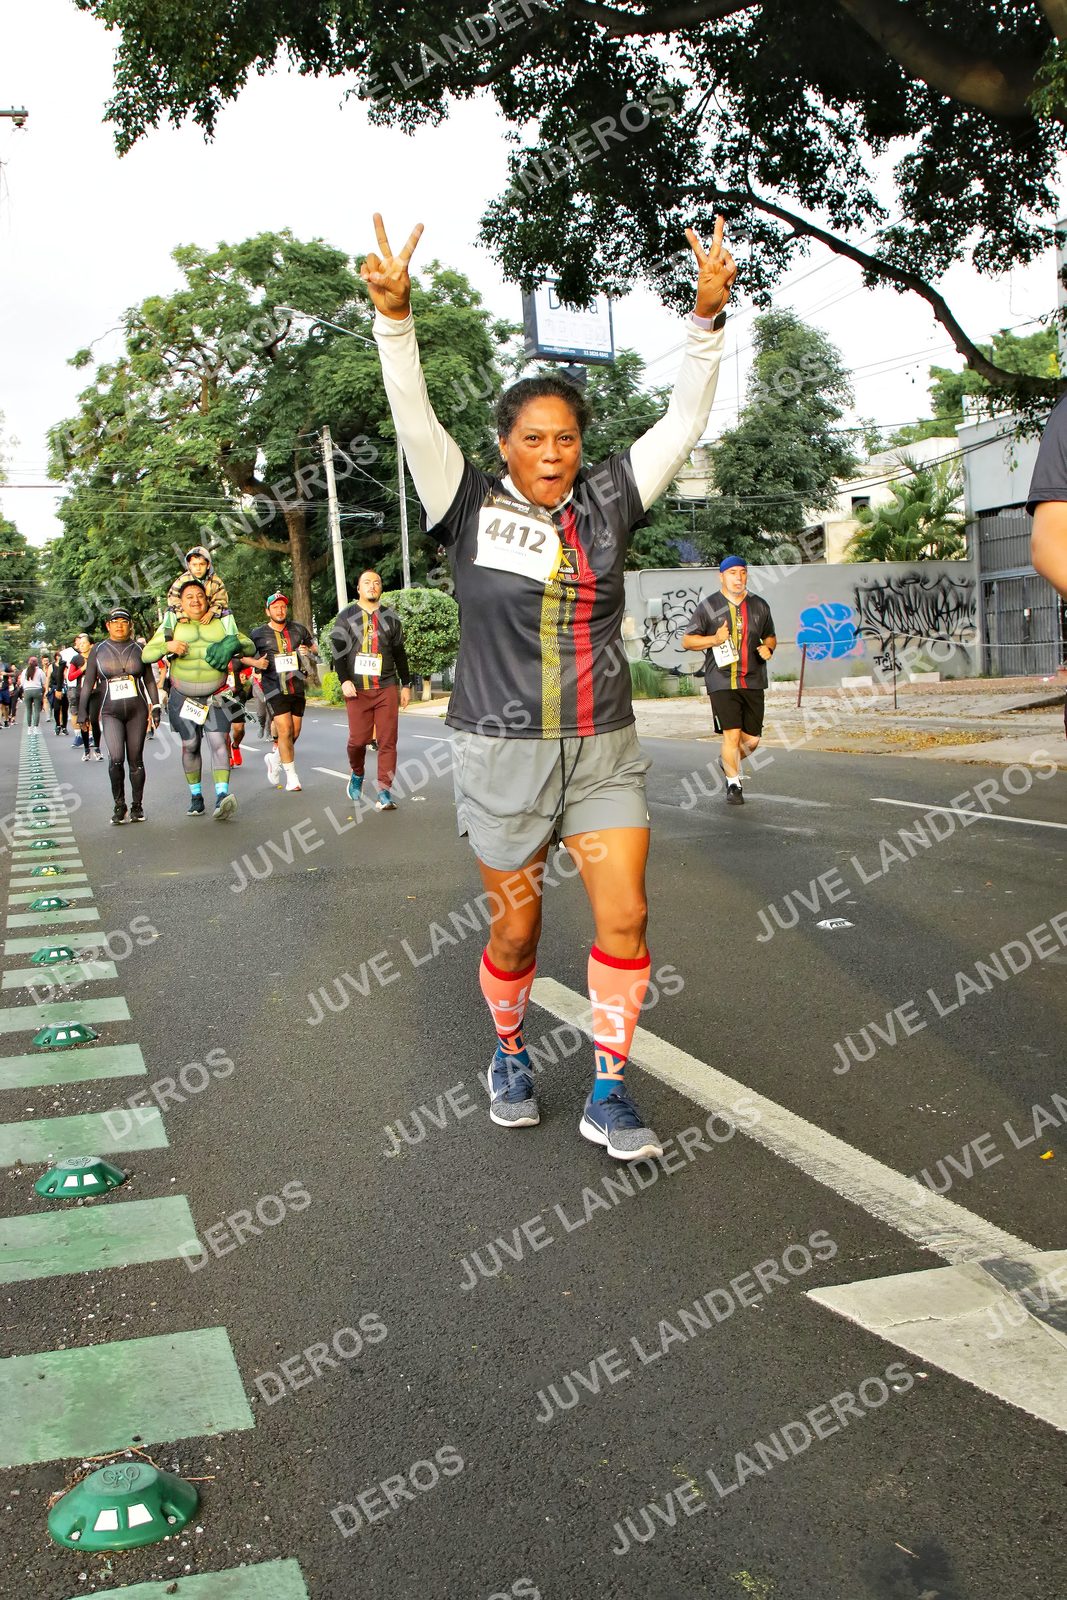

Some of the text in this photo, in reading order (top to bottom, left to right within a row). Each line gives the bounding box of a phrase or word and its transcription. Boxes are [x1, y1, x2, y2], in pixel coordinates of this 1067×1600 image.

[485, 518, 546, 554] 4412
[359, 660, 376, 668] 1216
[115, 683, 129, 692] 204
